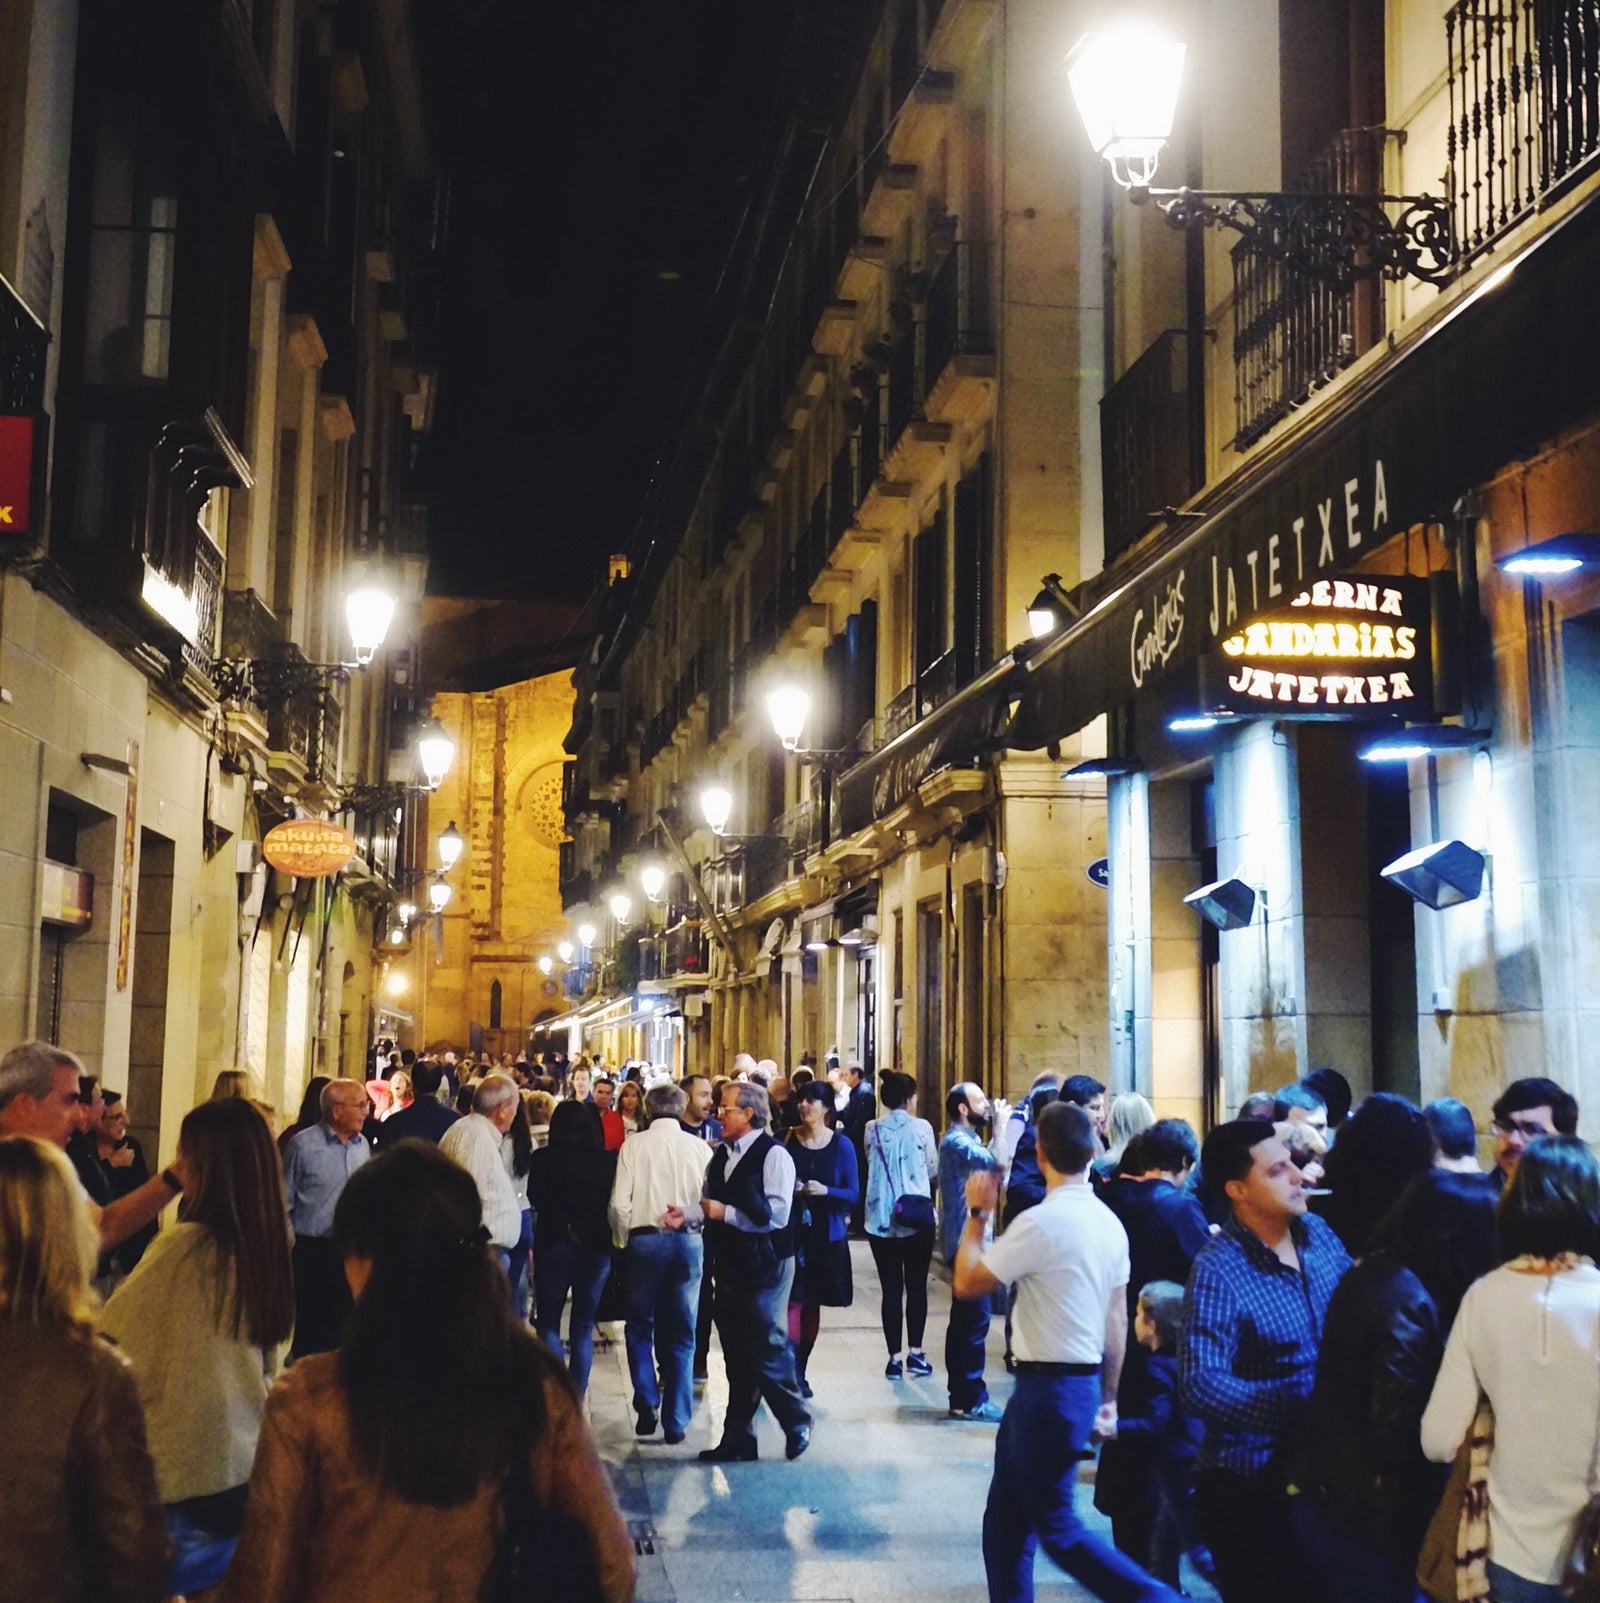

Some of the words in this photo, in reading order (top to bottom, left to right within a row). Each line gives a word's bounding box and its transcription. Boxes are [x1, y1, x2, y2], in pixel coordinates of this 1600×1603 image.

[1209, 459, 1388, 637] JATETXEA
[1290, 579, 1403, 617] ERNA
[1228, 666, 1415, 704] JATETXEA
[266, 842, 352, 856] matata
